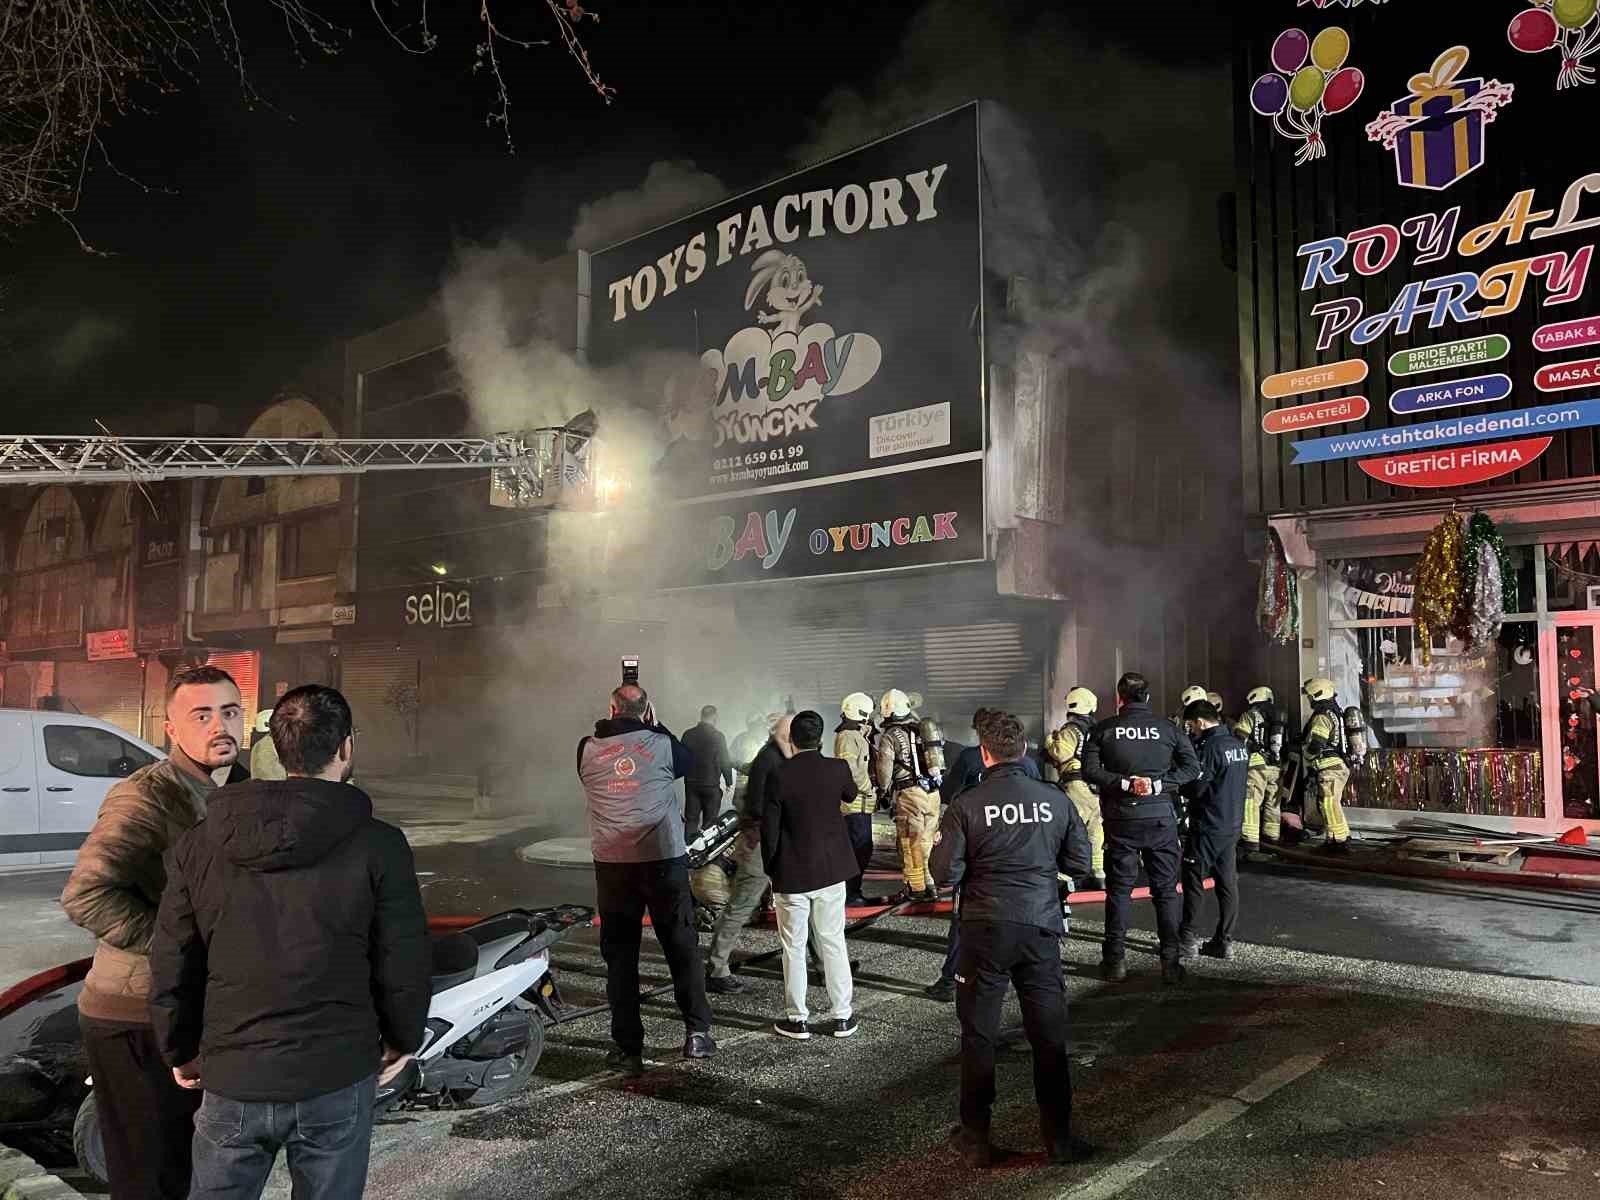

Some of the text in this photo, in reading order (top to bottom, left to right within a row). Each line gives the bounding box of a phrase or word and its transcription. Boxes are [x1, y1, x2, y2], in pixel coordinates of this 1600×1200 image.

[1296, 172, 1600, 291] ROYAL
[608, 163, 948, 322] TOYS FACTORY
[1310, 245, 1594, 351] PARTY
[1537, 326, 1597, 344] TABAK &
[1408, 345, 1447, 362] BRIDE
[1408, 351, 1487, 371] MALZEMELERİ
[1290, 371, 1336, 388] PEÇETE
[1549, 368, 1591, 383] MASA
[1416, 384, 1484, 404] ARKA FON
[1281, 412, 1314, 425] MASA
[1329, 409, 1580, 453] www.tahtakaledenal.com
[744, 452, 767, 465] 659
[769, 448, 785, 461] 61
[787, 444, 804, 458] 99
[1384, 448, 1523, 476] ÜRETİCİ FİRMA
[809, 511, 959, 555] OYUNCAK
[404, 584, 472, 629] selpa
